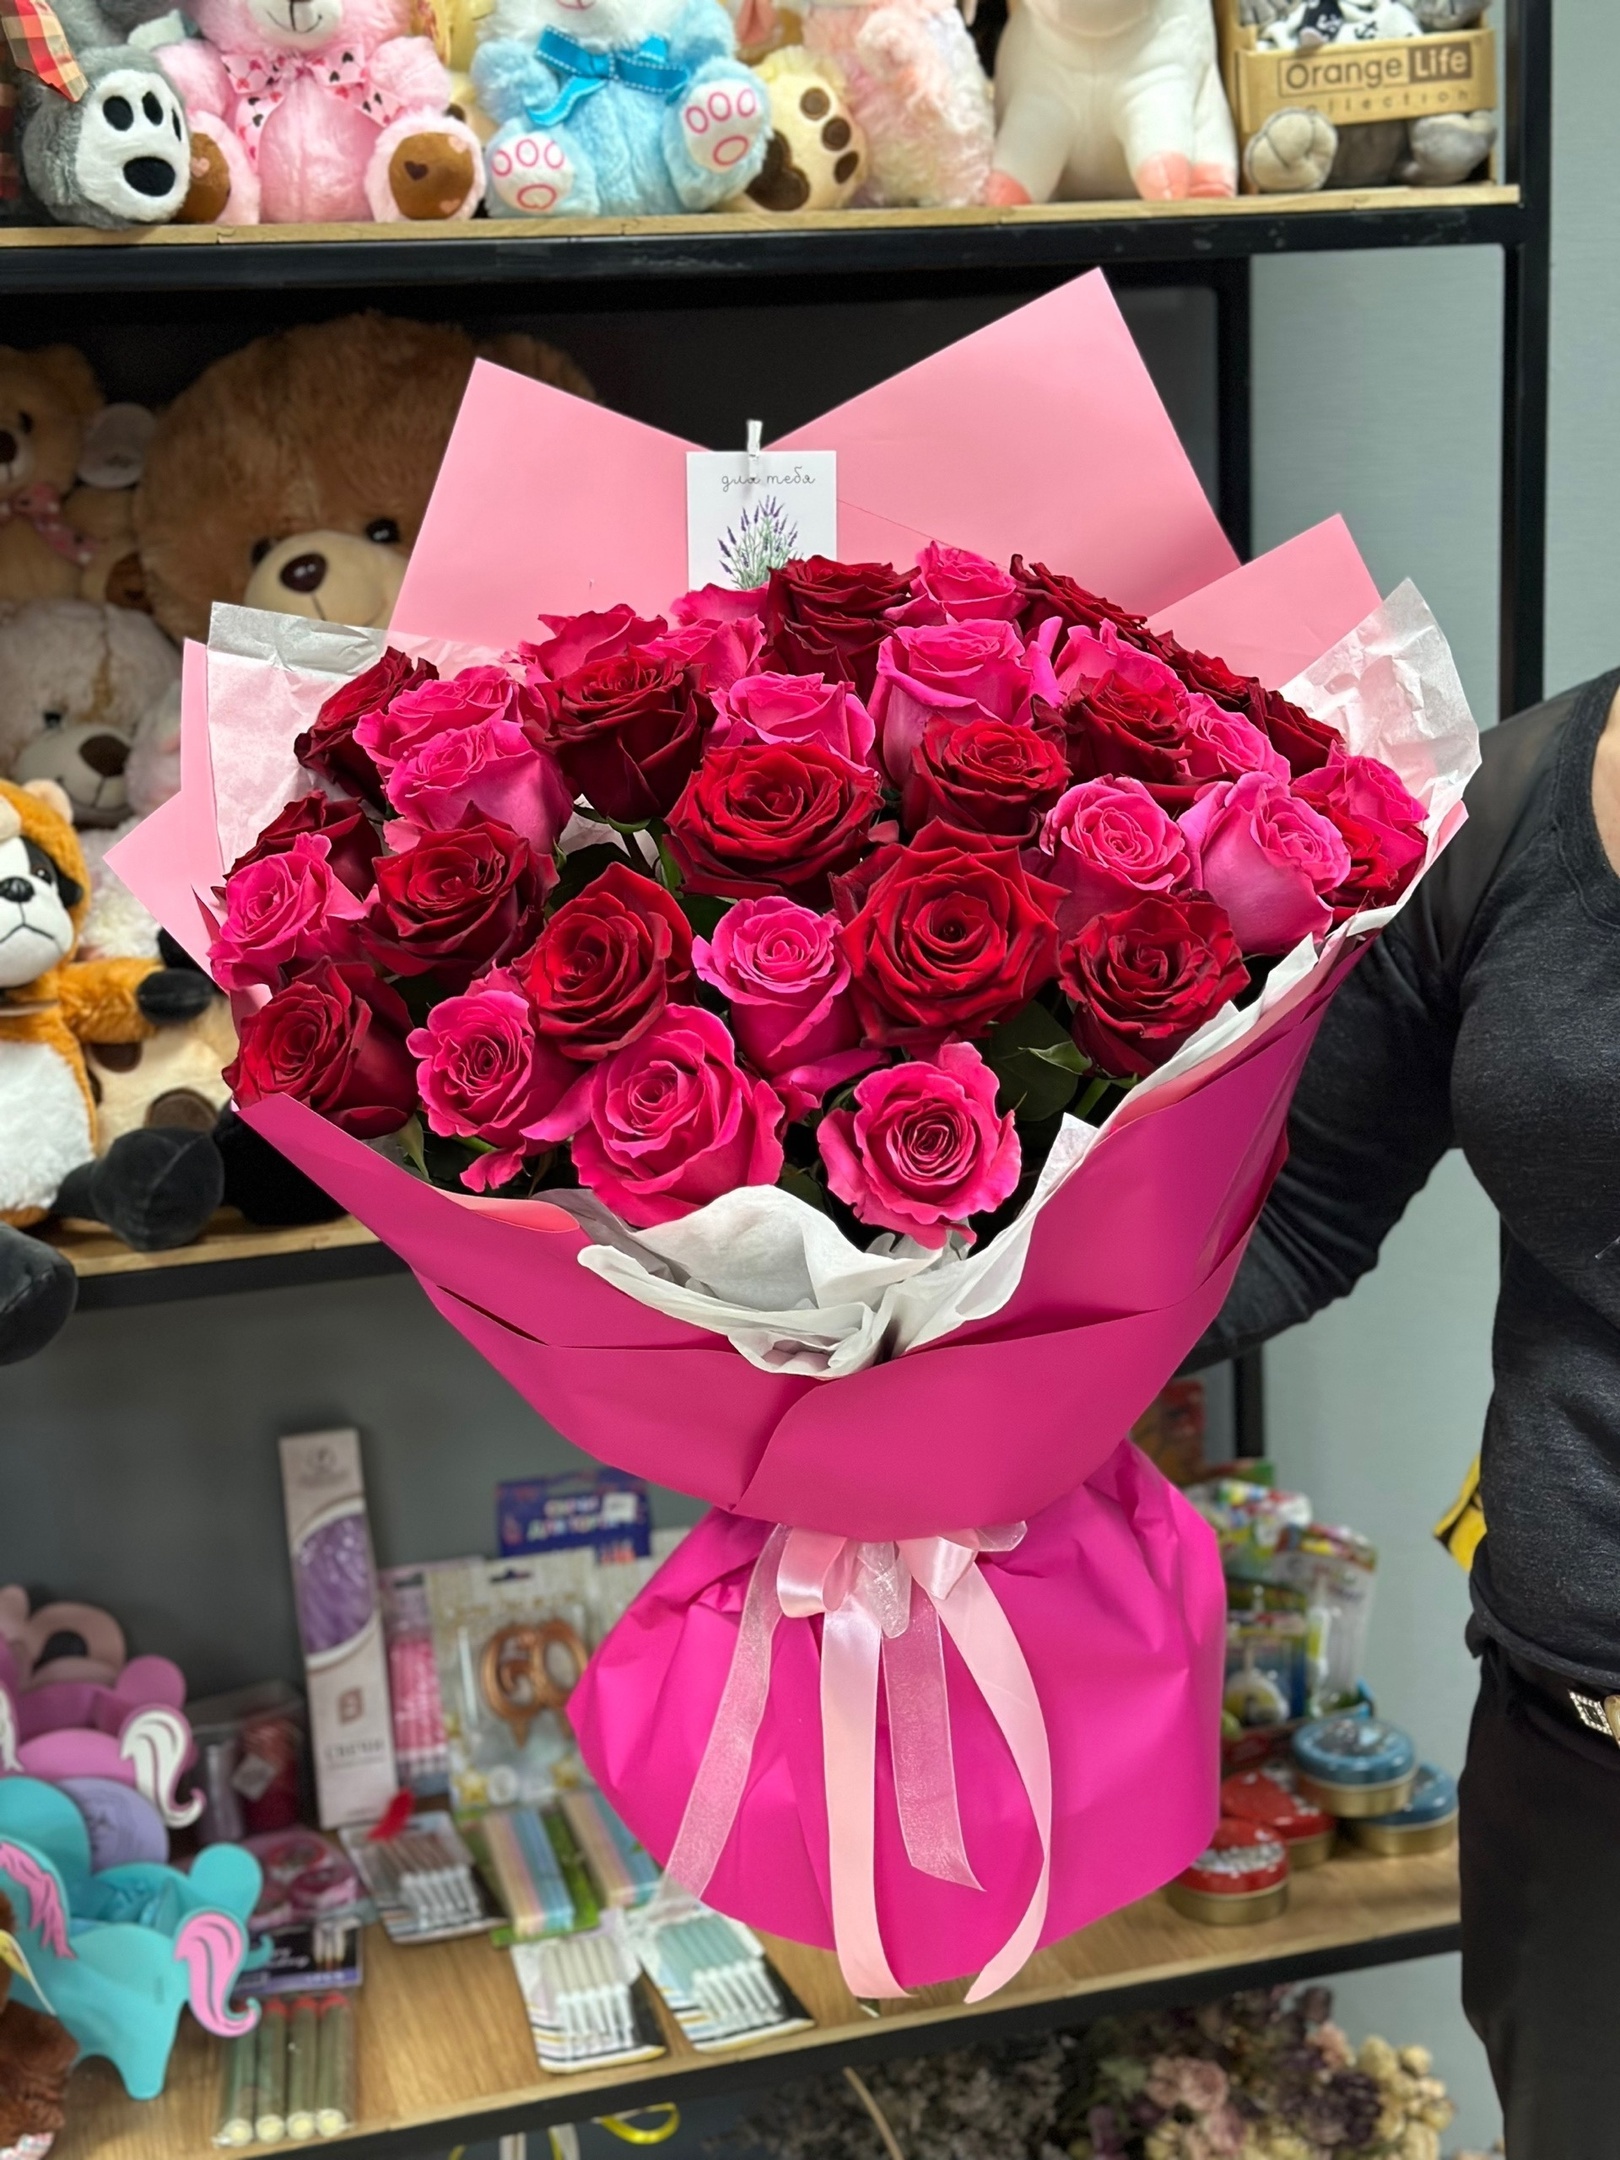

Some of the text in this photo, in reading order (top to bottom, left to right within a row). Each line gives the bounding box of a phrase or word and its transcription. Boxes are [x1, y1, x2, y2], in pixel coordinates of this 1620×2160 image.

[1286, 47, 1468, 89] Orange Life
[766, 465, 816, 484] тебя
